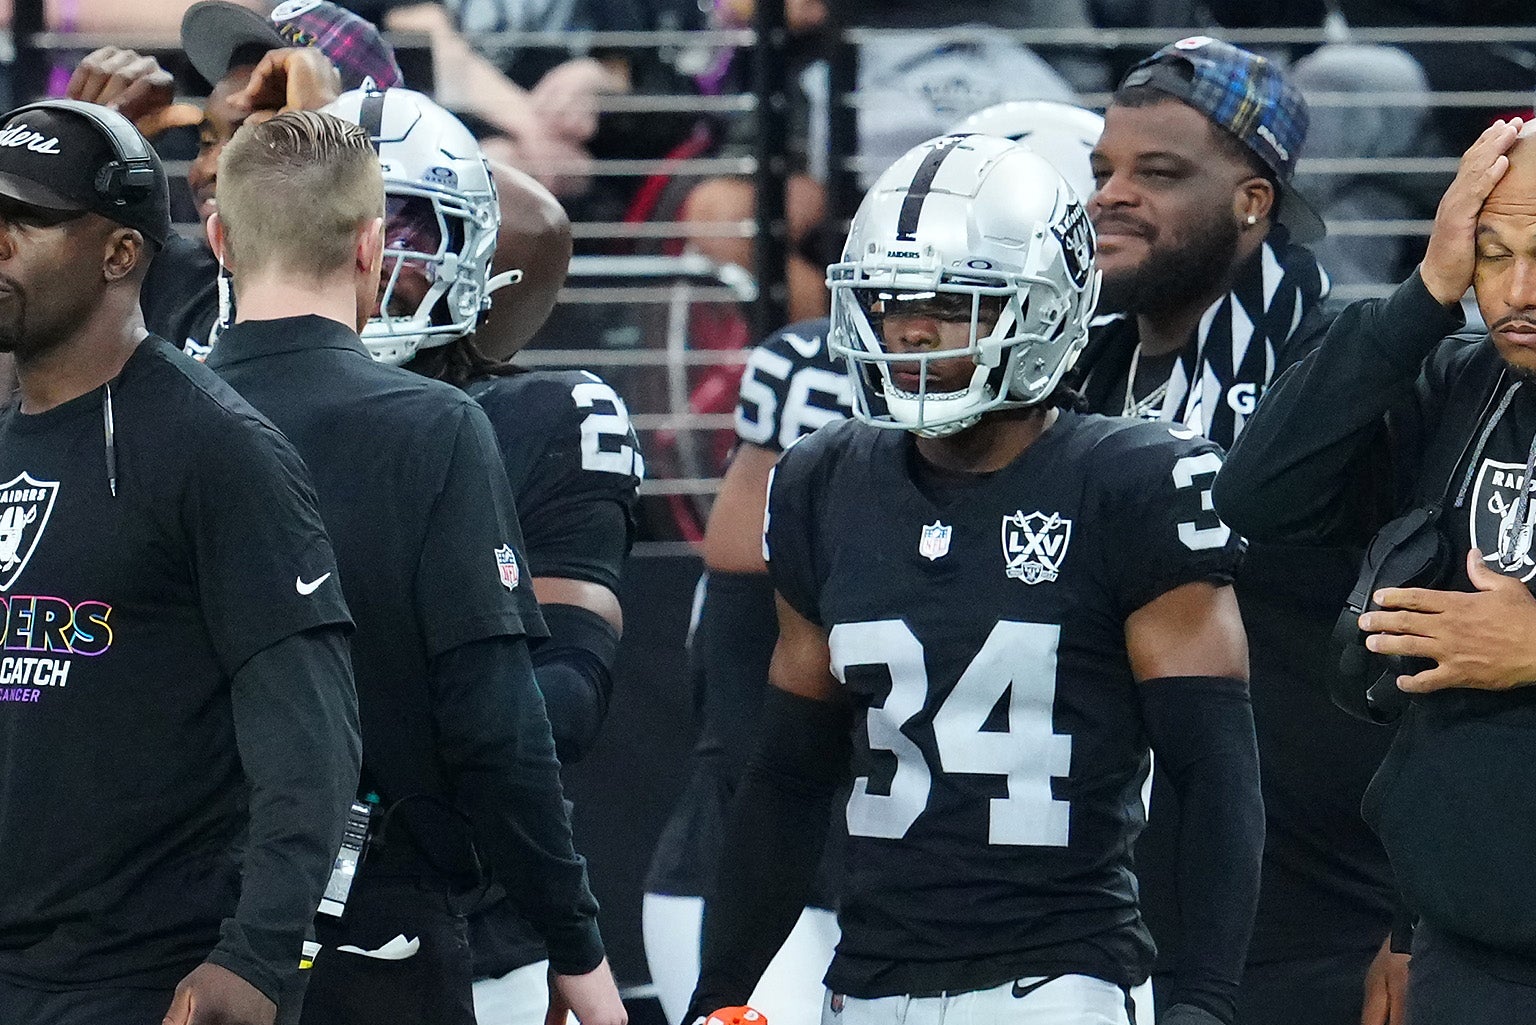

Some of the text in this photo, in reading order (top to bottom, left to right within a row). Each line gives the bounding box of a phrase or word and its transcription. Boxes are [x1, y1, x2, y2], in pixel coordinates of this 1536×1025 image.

[571, 383, 645, 483] 2
[0, 488, 47, 503] AIDERS
[1172, 452, 1249, 551] 3
[1008, 531, 1064, 557] LXV
[0, 657, 71, 687] CATCH
[828, 619, 1072, 847] 34
